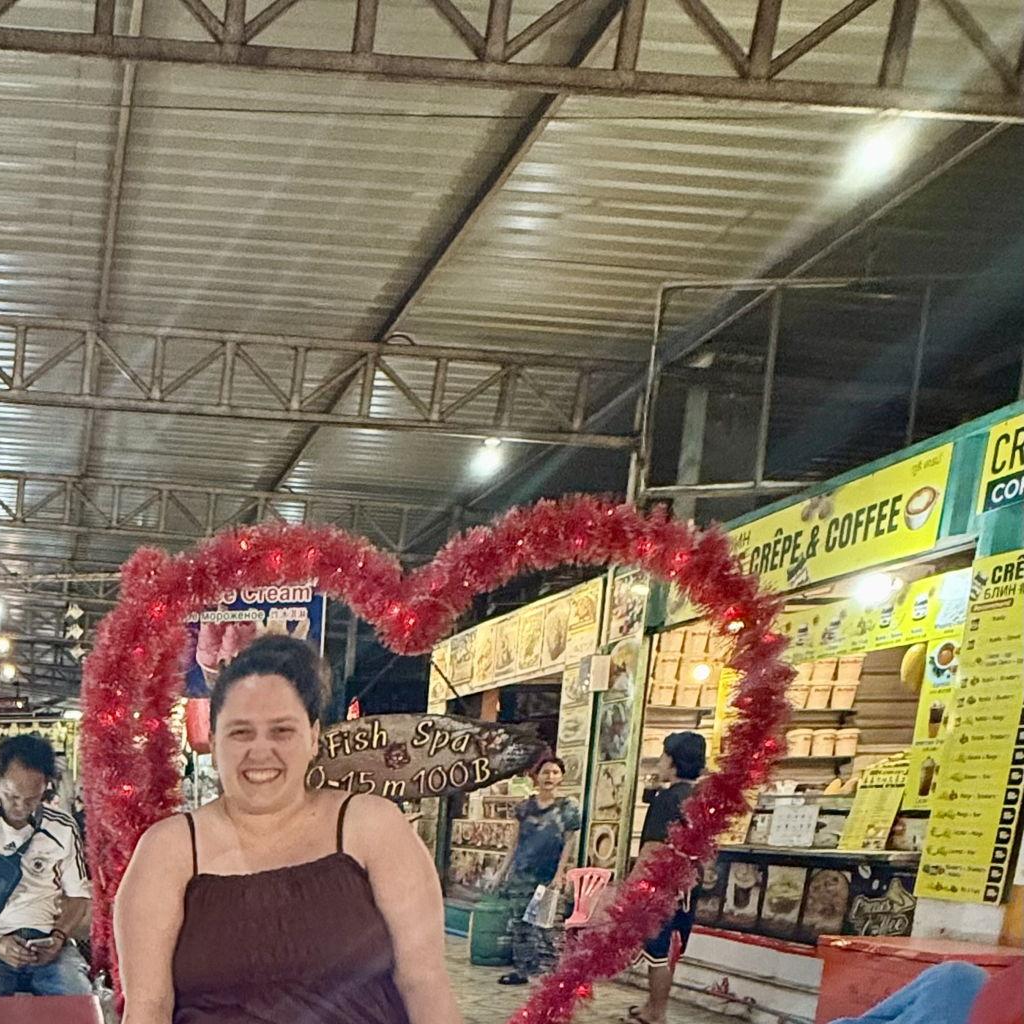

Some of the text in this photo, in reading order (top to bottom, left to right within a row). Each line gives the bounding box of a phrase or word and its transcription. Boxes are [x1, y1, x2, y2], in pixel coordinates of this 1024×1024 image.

[749, 527, 803, 575] CRÊPE
[806, 525, 820, 559] &
[825, 494, 903, 553] COFFEE
[242, 585, 311, 602] Cream
[984, 583, 1017, 600] БЛИН
[201, 611, 264, 622] мороженое
[326, 720, 471, 758] Fish Spa
